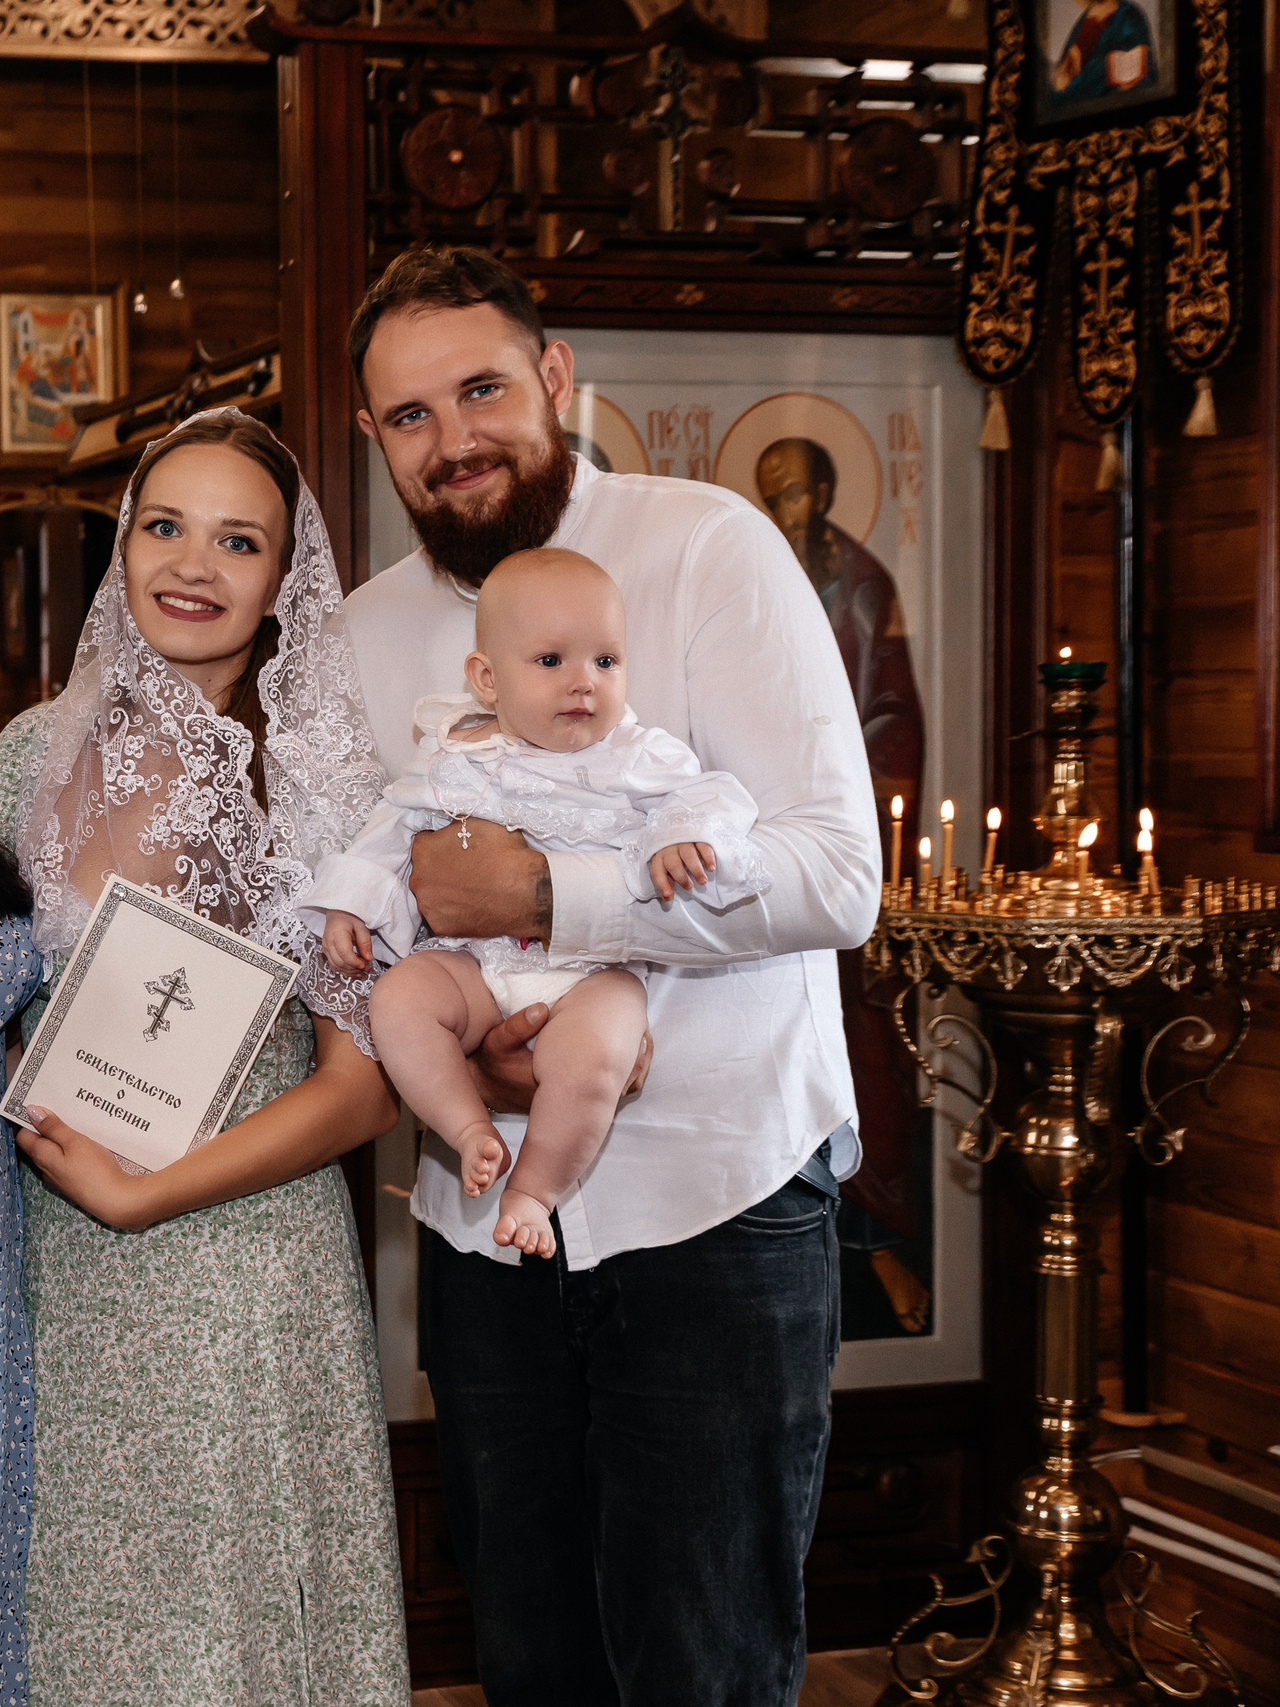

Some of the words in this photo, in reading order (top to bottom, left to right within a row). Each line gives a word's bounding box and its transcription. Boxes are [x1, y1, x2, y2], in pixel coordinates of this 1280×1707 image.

[76, 1049, 182, 1109] СВИДЕТЕЛЬСТВО
[116, 1089, 125, 1100] О
[76, 1087, 151, 1132] КРЕЩЕНИИ
